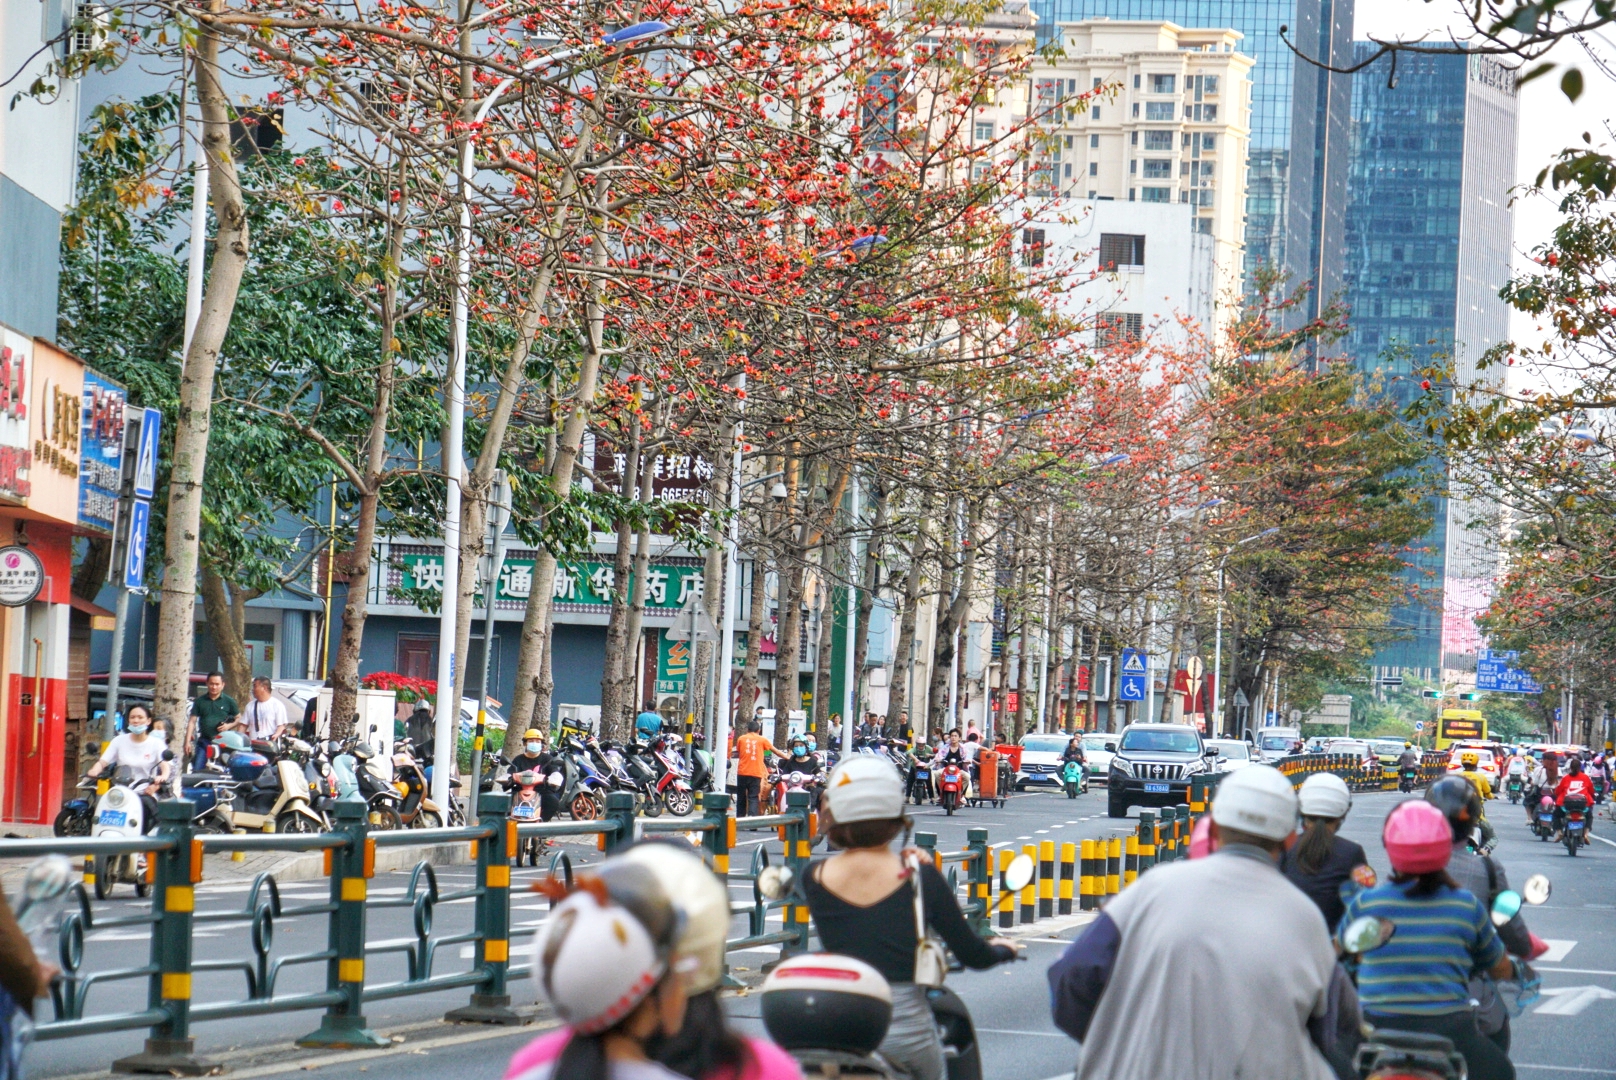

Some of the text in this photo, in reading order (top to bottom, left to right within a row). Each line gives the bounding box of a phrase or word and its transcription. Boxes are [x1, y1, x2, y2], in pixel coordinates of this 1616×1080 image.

[410, 558, 705, 604] 快通新华药店
